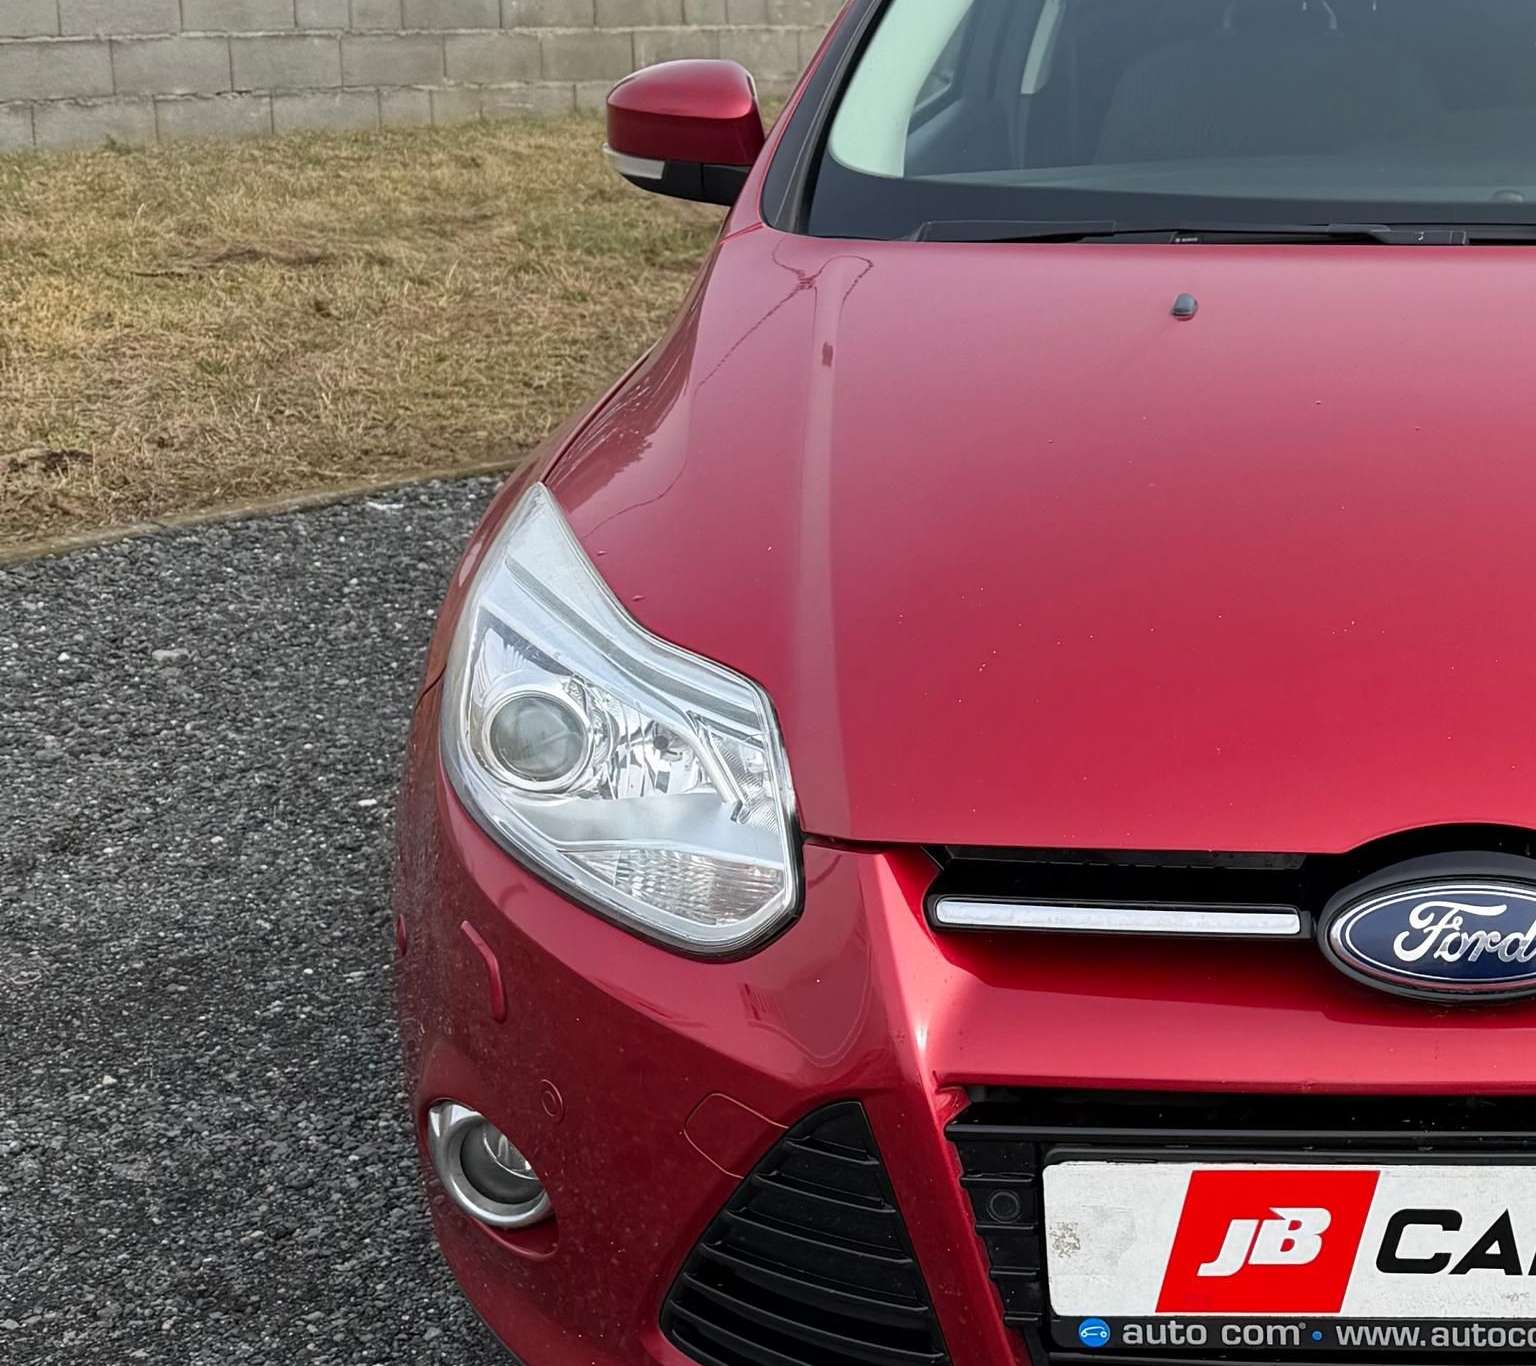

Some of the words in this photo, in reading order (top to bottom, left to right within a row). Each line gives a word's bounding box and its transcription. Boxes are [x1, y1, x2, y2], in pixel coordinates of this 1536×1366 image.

[1196, 1206, 1332, 1277] JB
[1121, 1319, 1208, 1346] auto
[1220, 1322, 1301, 1346] com
